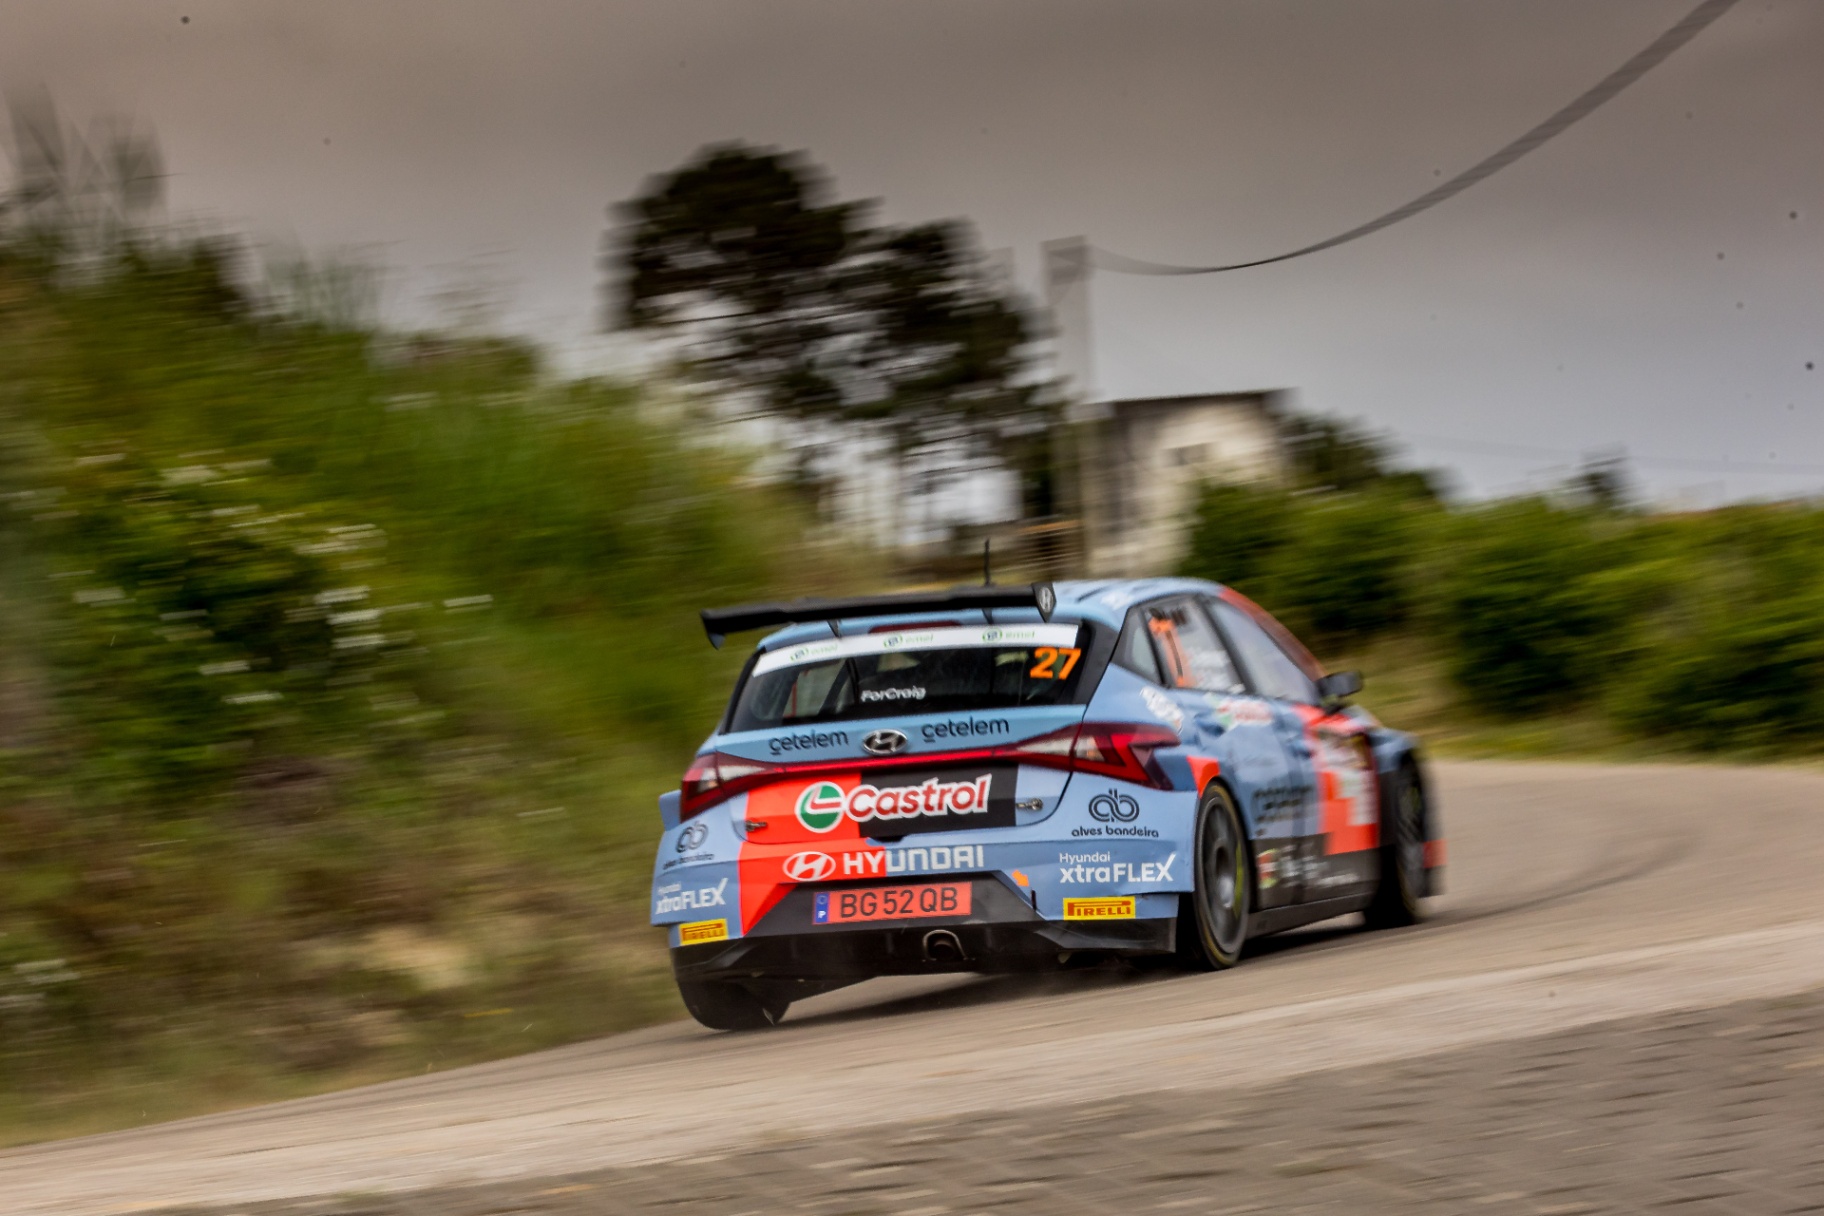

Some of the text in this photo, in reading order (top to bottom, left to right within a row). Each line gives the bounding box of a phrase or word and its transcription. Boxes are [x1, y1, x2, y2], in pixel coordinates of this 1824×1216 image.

[1029, 646, 1081, 680] 27
[846, 774, 992, 822] Castrol
[1071, 825, 1159, 838] alves bandeira
[842, 845, 984, 875] HYUNDAI
[1059, 851, 1111, 865] Hyundai
[840, 887, 958, 919] BG 52 QB
[1067, 900, 1132, 917] PIRELLI
